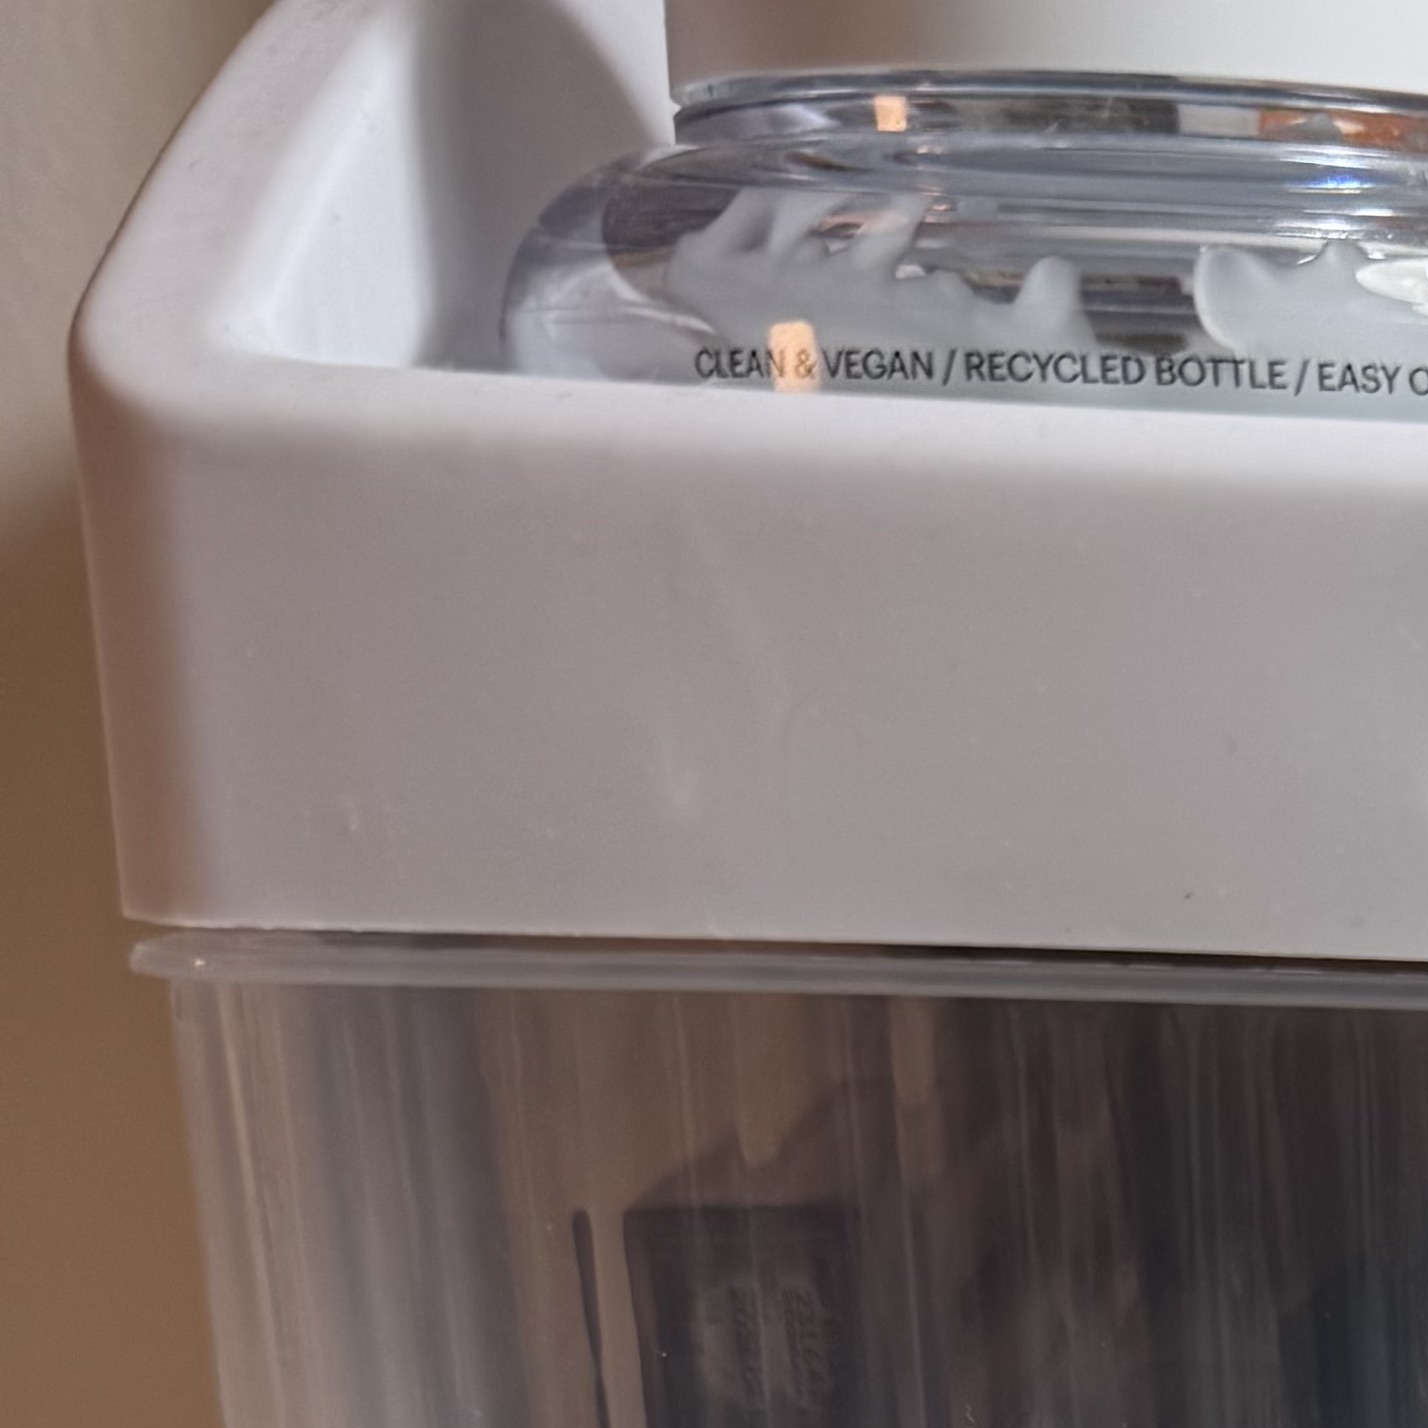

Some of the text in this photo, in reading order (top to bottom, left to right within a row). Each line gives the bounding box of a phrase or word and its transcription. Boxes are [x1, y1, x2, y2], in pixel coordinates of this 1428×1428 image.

[694, 348, 784, 379] CLEAN
[794, 350, 817, 379] &
[824, 349, 934, 382] VEGAN
[942, 348, 956, 386] /
[965, 350, 1147, 386] RECYCLED
[1155, 357, 1288, 390] BOTTLE
[1294, 359, 1309, 397] /
[1318, 362, 1403, 395] EASY
